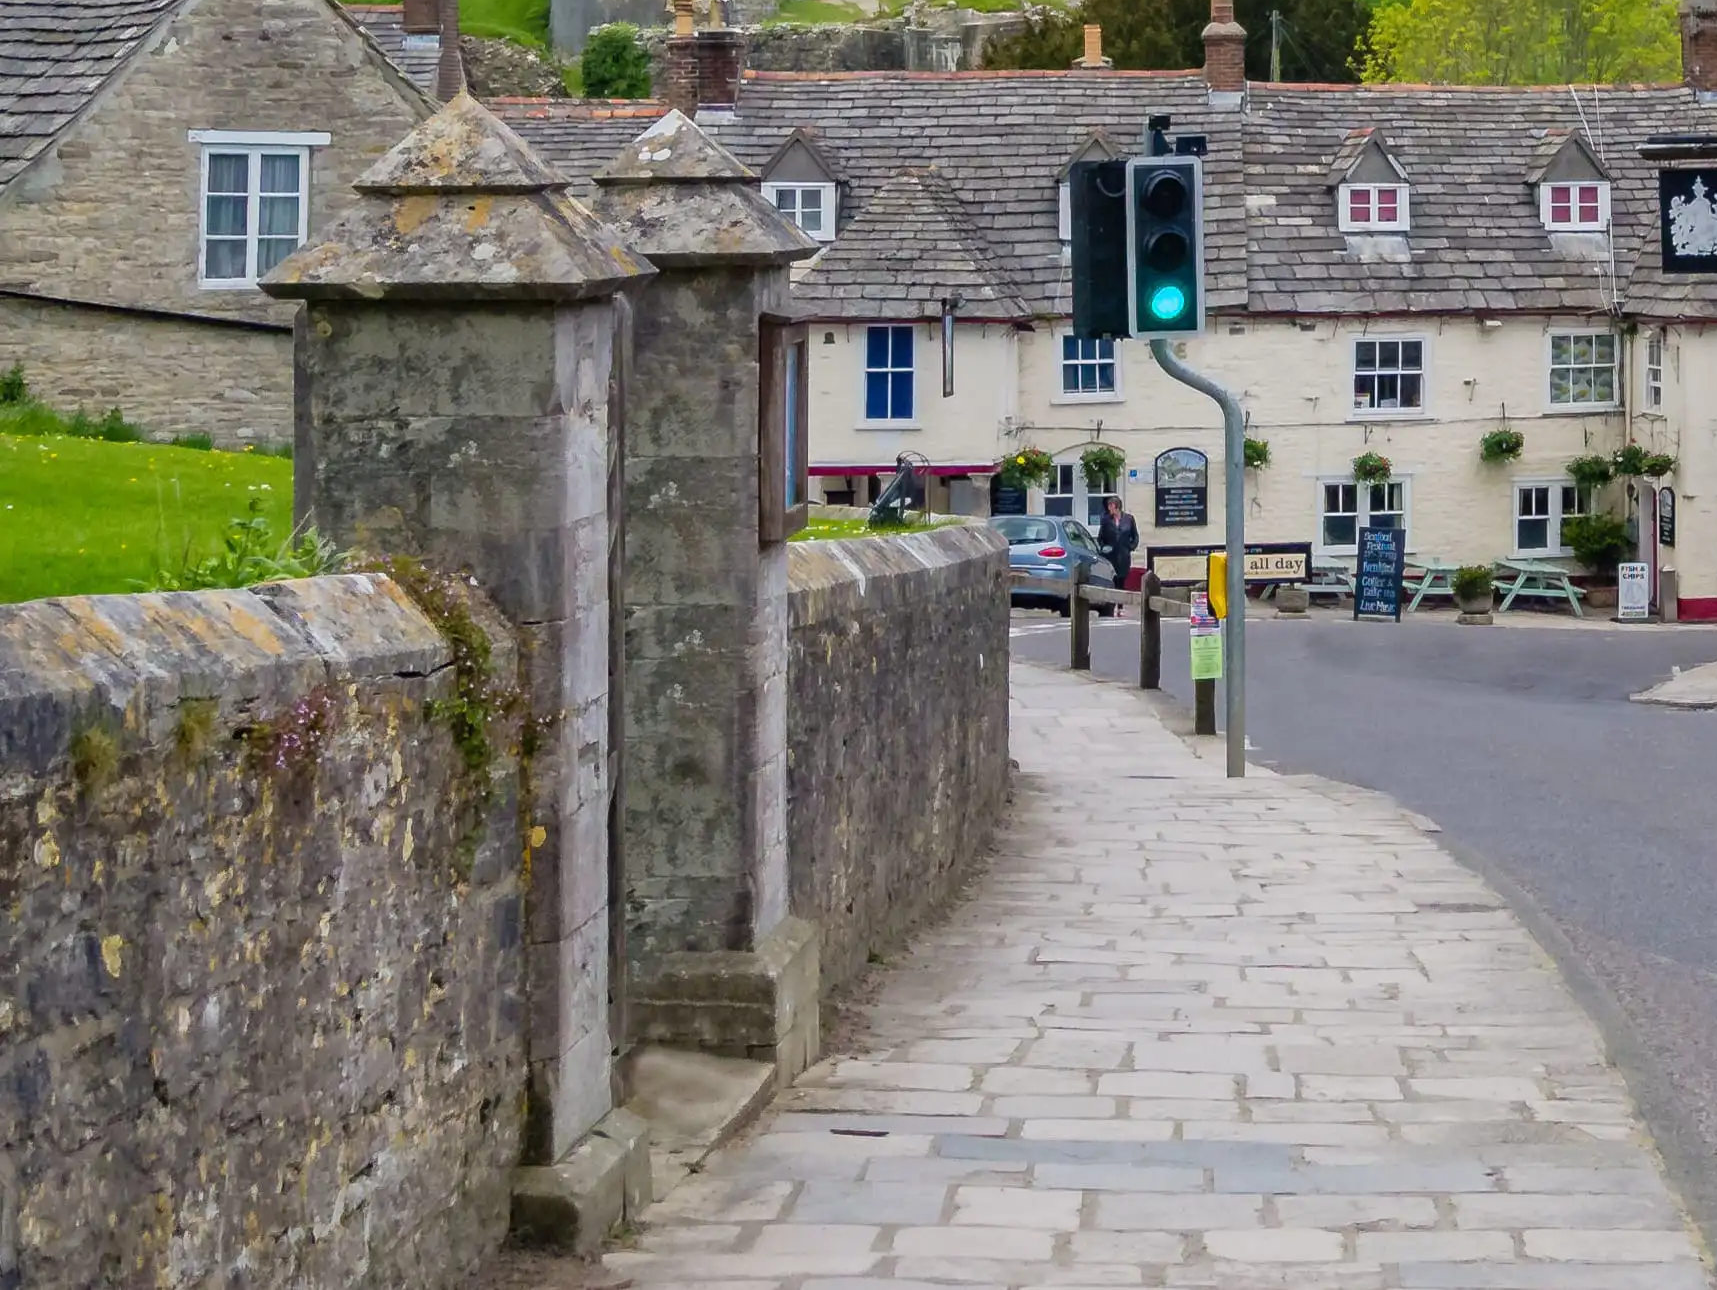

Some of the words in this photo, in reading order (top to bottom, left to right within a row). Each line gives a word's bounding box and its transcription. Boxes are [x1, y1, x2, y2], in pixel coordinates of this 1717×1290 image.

[1250, 557, 1270, 570] all
[1275, 557, 1304, 574] day
[1360, 600, 1376, 611] Live
[1376, 600, 1396, 613] Music
